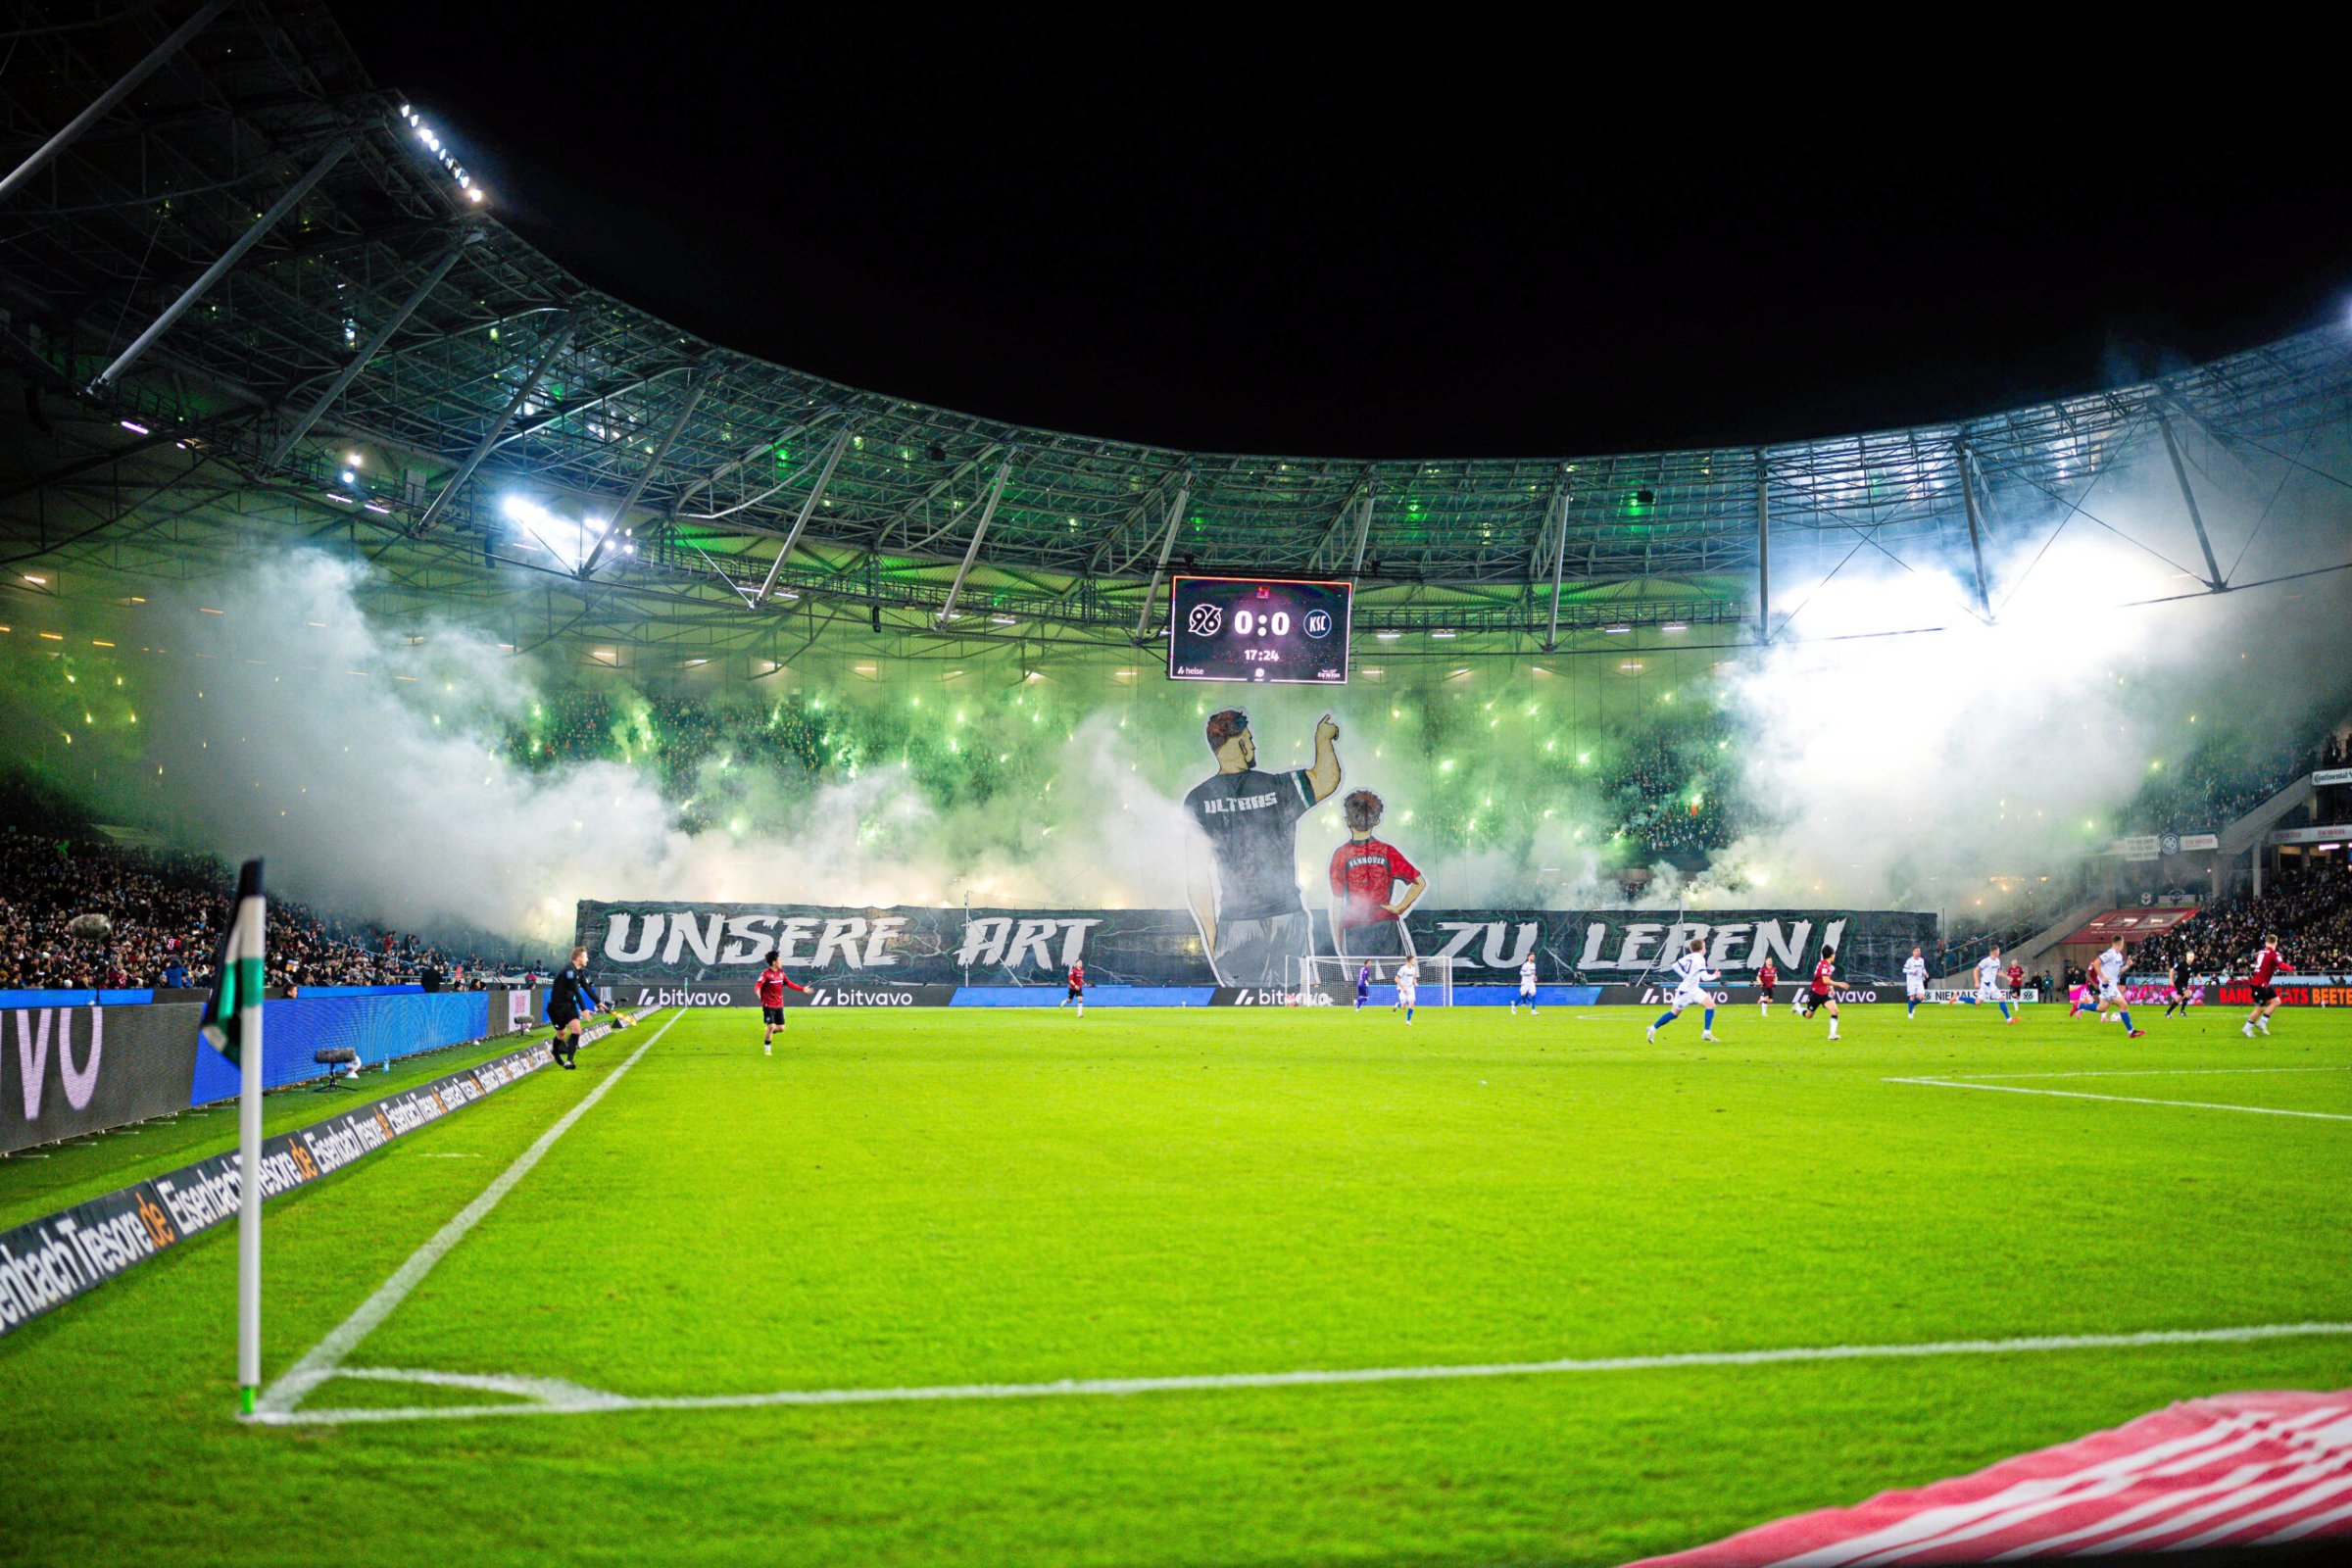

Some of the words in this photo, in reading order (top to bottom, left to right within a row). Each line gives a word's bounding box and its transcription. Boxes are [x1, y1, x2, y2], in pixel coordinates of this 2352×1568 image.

[1234, 610, 1291, 636] 0:0
[1309, 615, 1327, 632] KSC
[1244, 649, 1280, 662] 17:24
[1203, 792, 1278, 813] ULTRAS
[1348, 856, 1388, 868] HANNOVER
[604, 910, 914, 971] UNSERE
[952, 916, 1103, 971] ART
[1429, 920, 1539, 968] ZU
[659, 988, 731, 1005] bitvavo
[837, 988, 913, 1005] bitvavo
